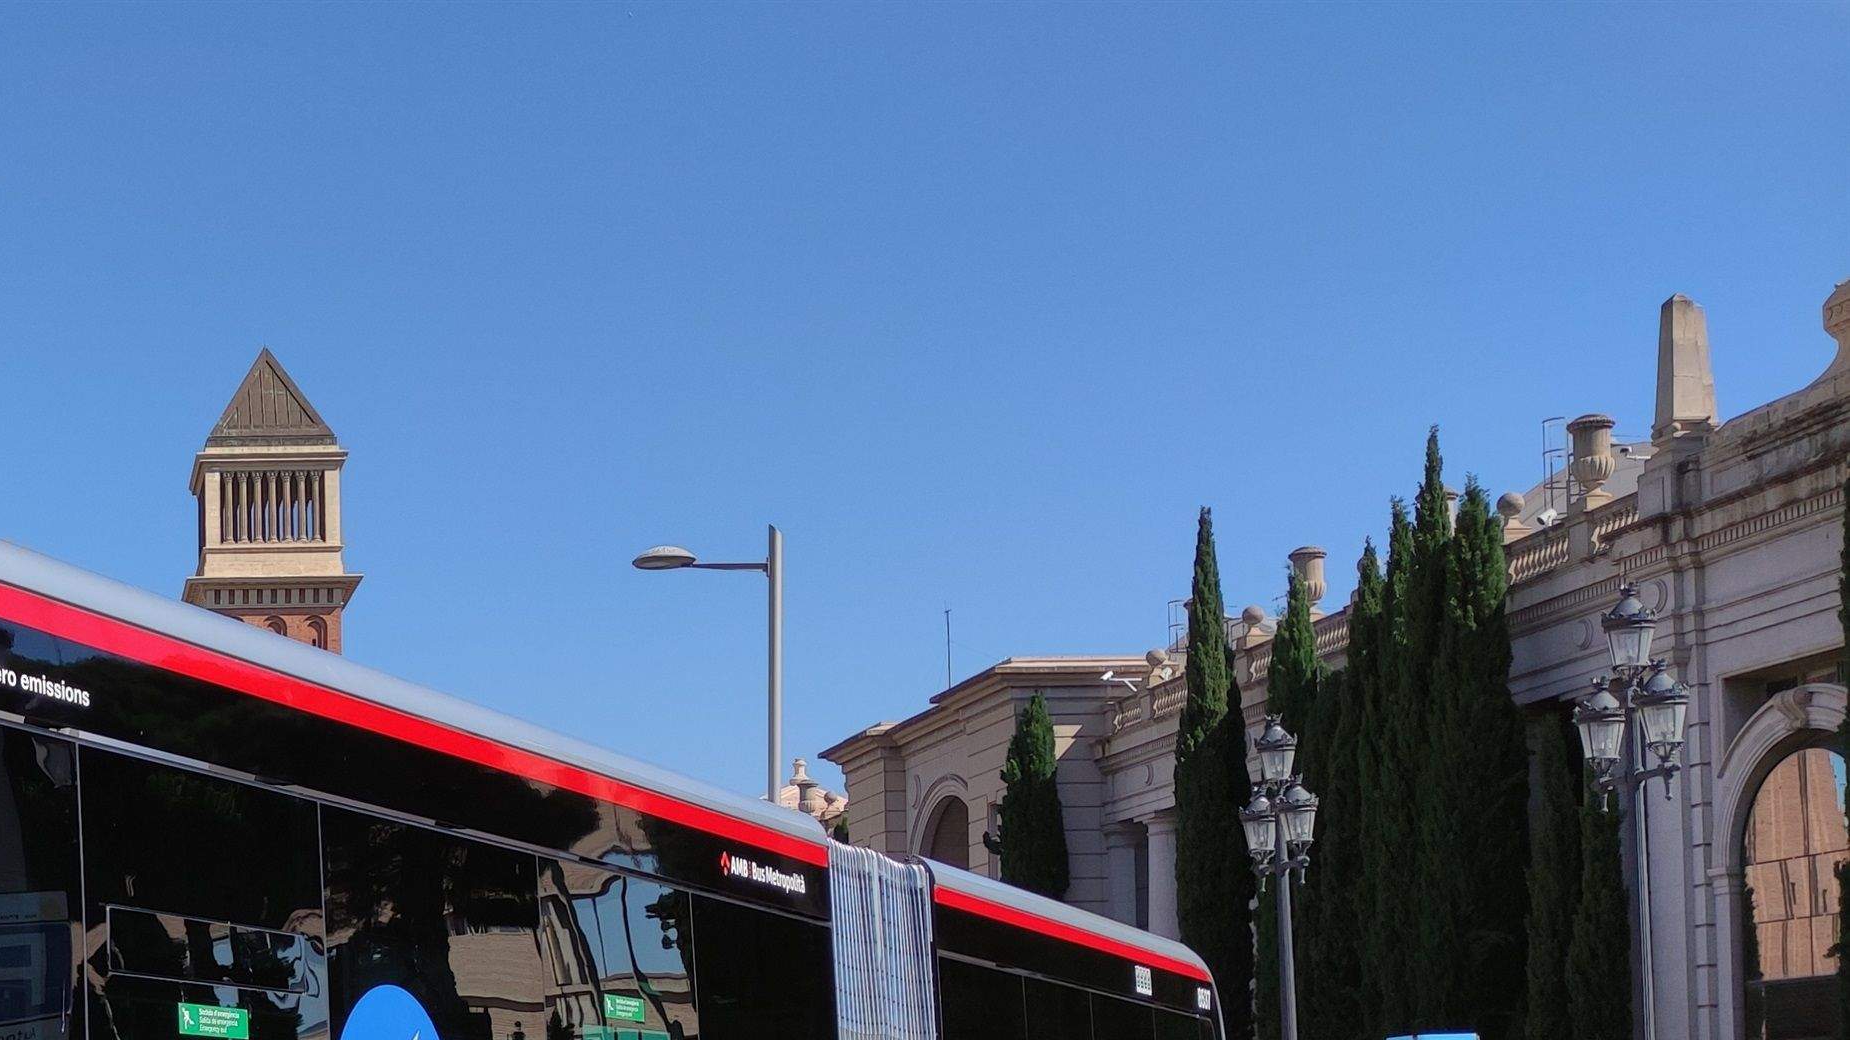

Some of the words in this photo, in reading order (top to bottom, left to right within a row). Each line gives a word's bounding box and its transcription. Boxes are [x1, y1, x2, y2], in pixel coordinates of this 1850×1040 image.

[20, 674, 91, 708] emissions
[731, 855, 749, 878] AMB
[751, 861, 766, 883] Bus
[765, 865, 807, 894] Metropolità
